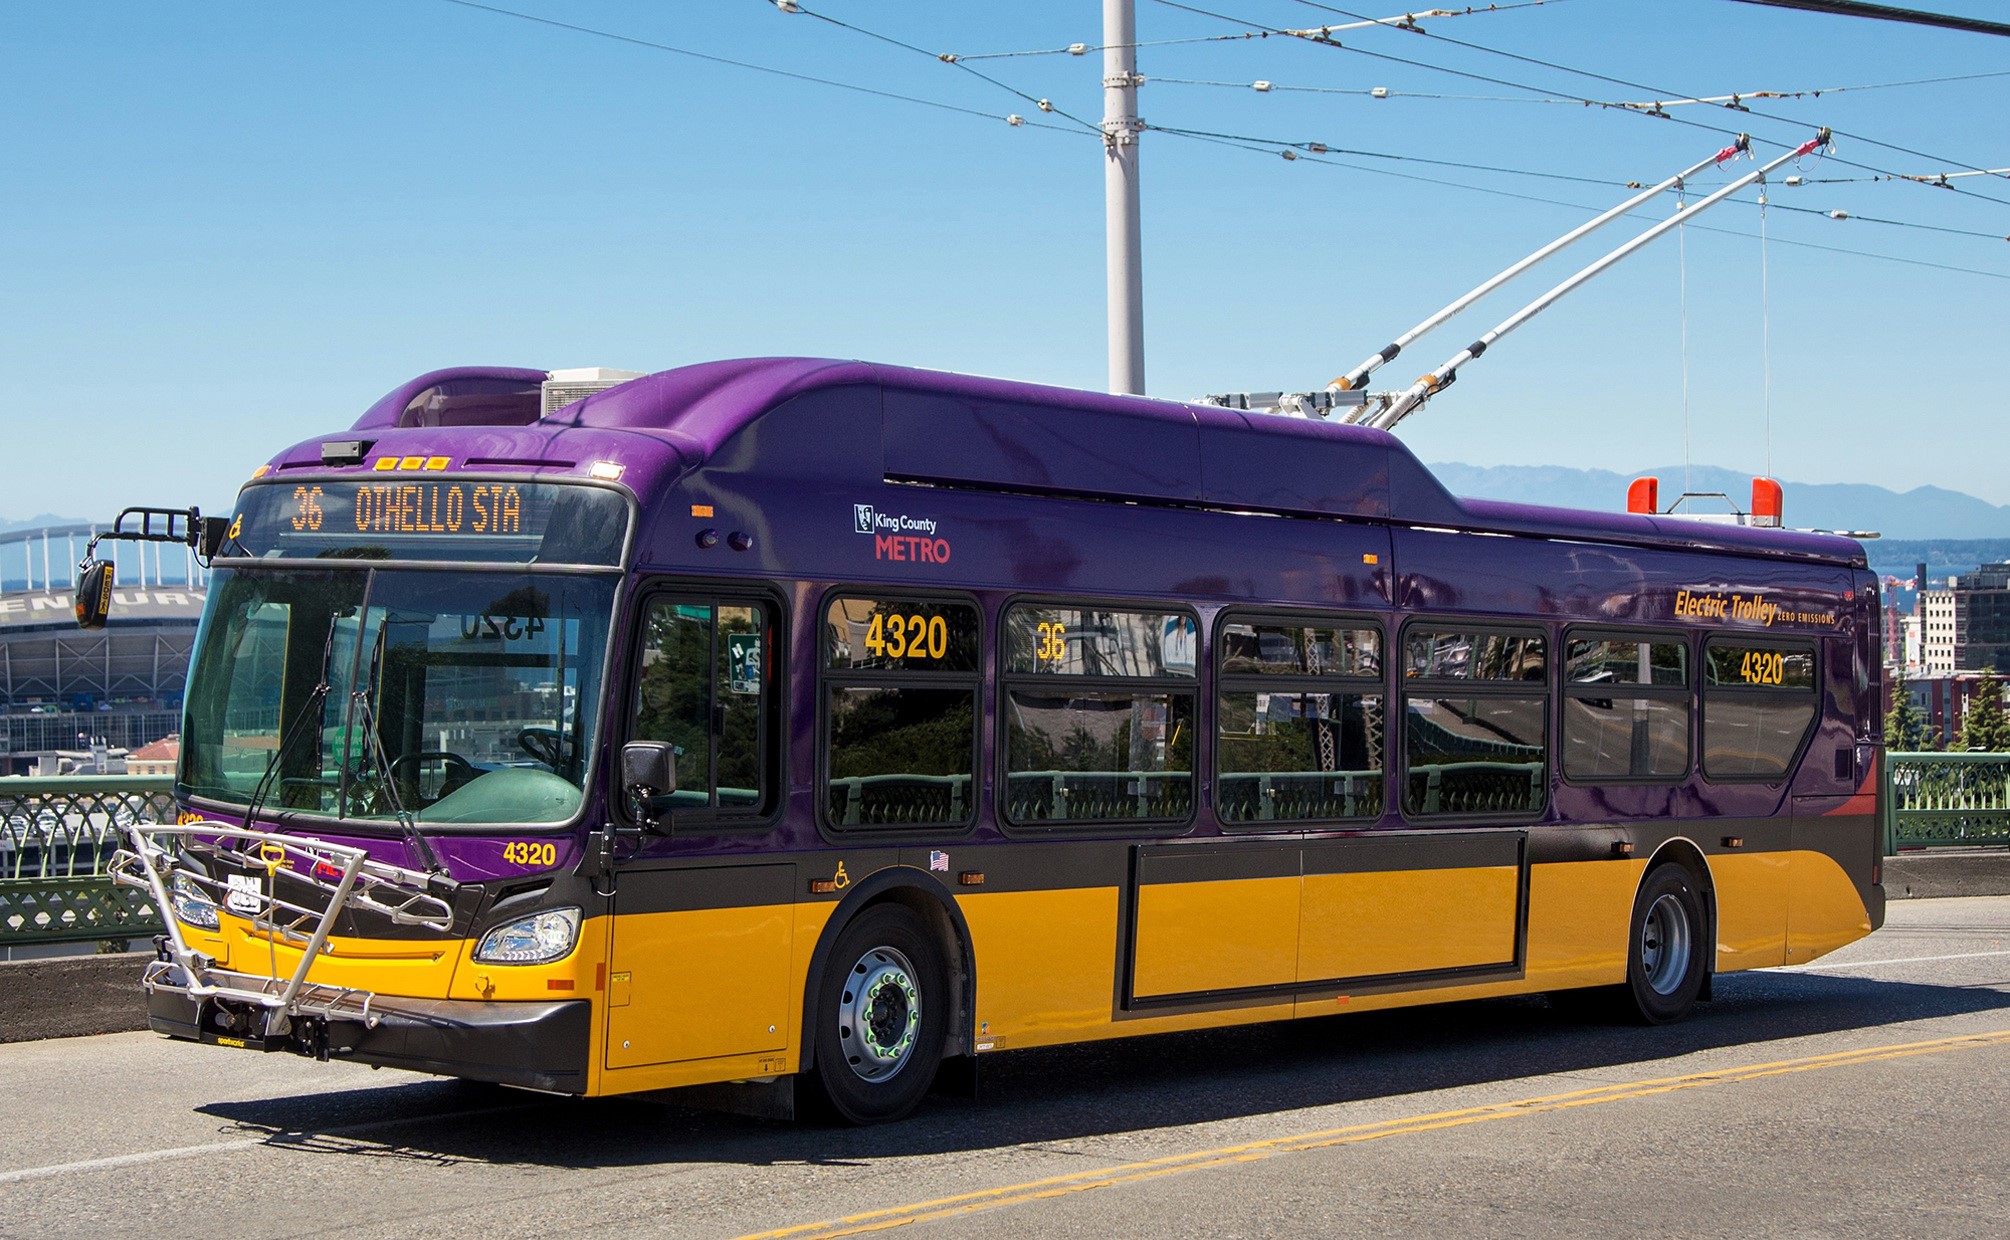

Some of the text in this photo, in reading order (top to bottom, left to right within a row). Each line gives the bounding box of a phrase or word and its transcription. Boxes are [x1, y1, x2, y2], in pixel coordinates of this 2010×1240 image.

[292, 486, 520, 532] 36 OTHELLO STA
[875, 513, 936, 535] King County
[875, 534, 951, 564] METRO
[102, 574, 112, 600] PEDS
[1674, 590, 1835, 628] Electric Trolley ZERO EMISSIONS
[865, 613, 948, 659] 4320
[1037, 622, 1066, 660] 36
[1741, 651, 1784, 685] 4320
[503, 841, 556, 866] 4320
